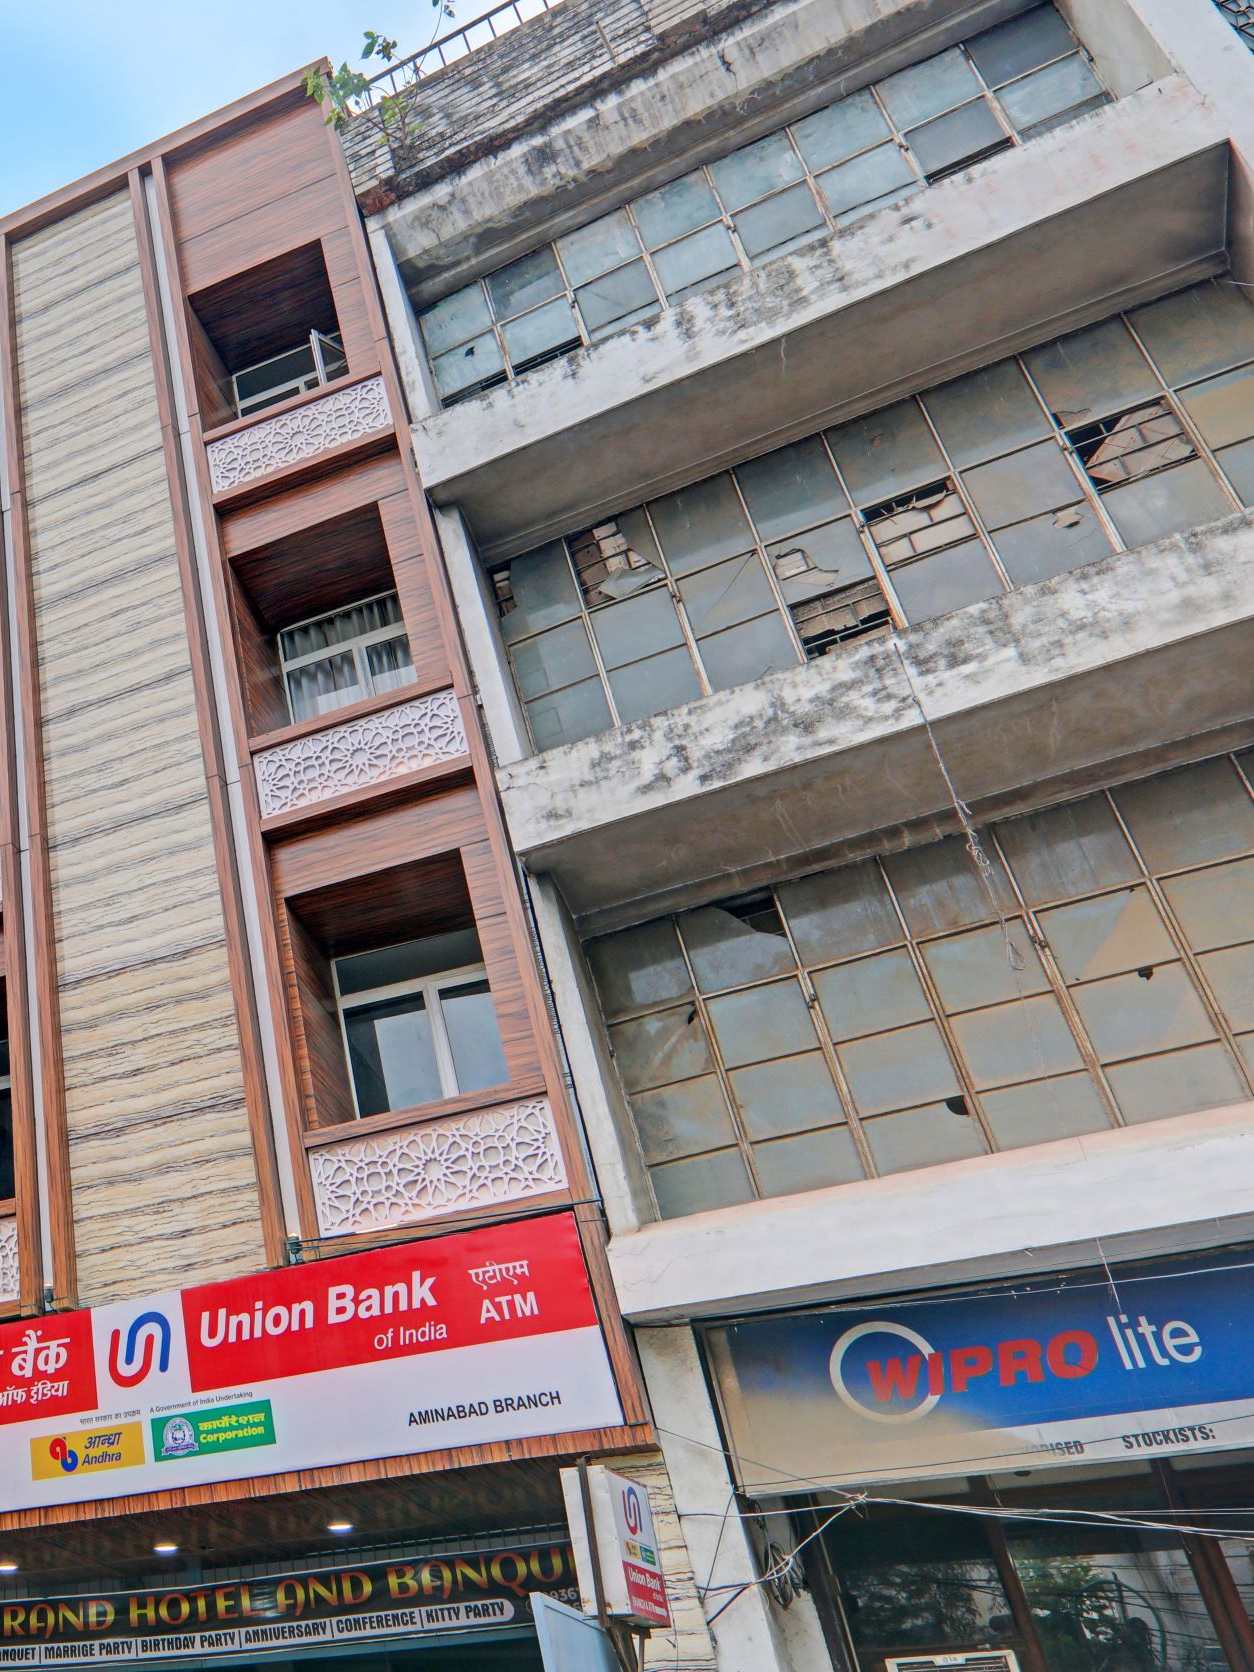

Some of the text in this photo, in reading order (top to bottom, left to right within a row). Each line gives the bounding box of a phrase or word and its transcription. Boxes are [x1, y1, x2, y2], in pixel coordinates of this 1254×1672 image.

[468, 1259, 530, 1291] एटीएम
[199, 1269, 438, 1348] Union Bank
[479, 1291, 540, 1324] ATM
[373, 1321, 448, 1351] of India
[11, 1329, 71, 1378] बैंक
[865, 1313, 1203, 1402] WIPRO lite
[29, 1380, 69, 1405] इंडिया
[155, 1400, 191, 1413] Government
[199, 1397, 215, 1405] India
[215, 1391, 253, 1402] Undertaking
[79, 1417, 94, 1425] भारत
[95, 1414, 113, 1423] सरकार
[114, 1412, 122, 1420] का
[407, 1391, 562, 1427] AMINABAD BRANCH
[84, 1432, 123, 1450] आन्ध्रा
[199, 1425, 265, 1443] Corporation
[1122, 1425, 1216, 1450] STOCKISTS:
[82, 1451, 122, 1466] Andhra
[128, 1585, 267, 1628] HOTEL
[276, 1571, 373, 1617] AND
[45, 1644, 95, 1660] MARRIGE
[99, 1641, 133, 1656] PARTY
[141, 1635, 196, 1653] BIRTHDAY
[200, 1631, 236, 1648] PARTY
[246, 1621, 327, 1643] ANNIVERSARY
[336, 1611, 417, 1633] CONFERENCE
[426, 1605, 461, 1623] KITTY
[465, 1602, 505, 1619] PARTY
